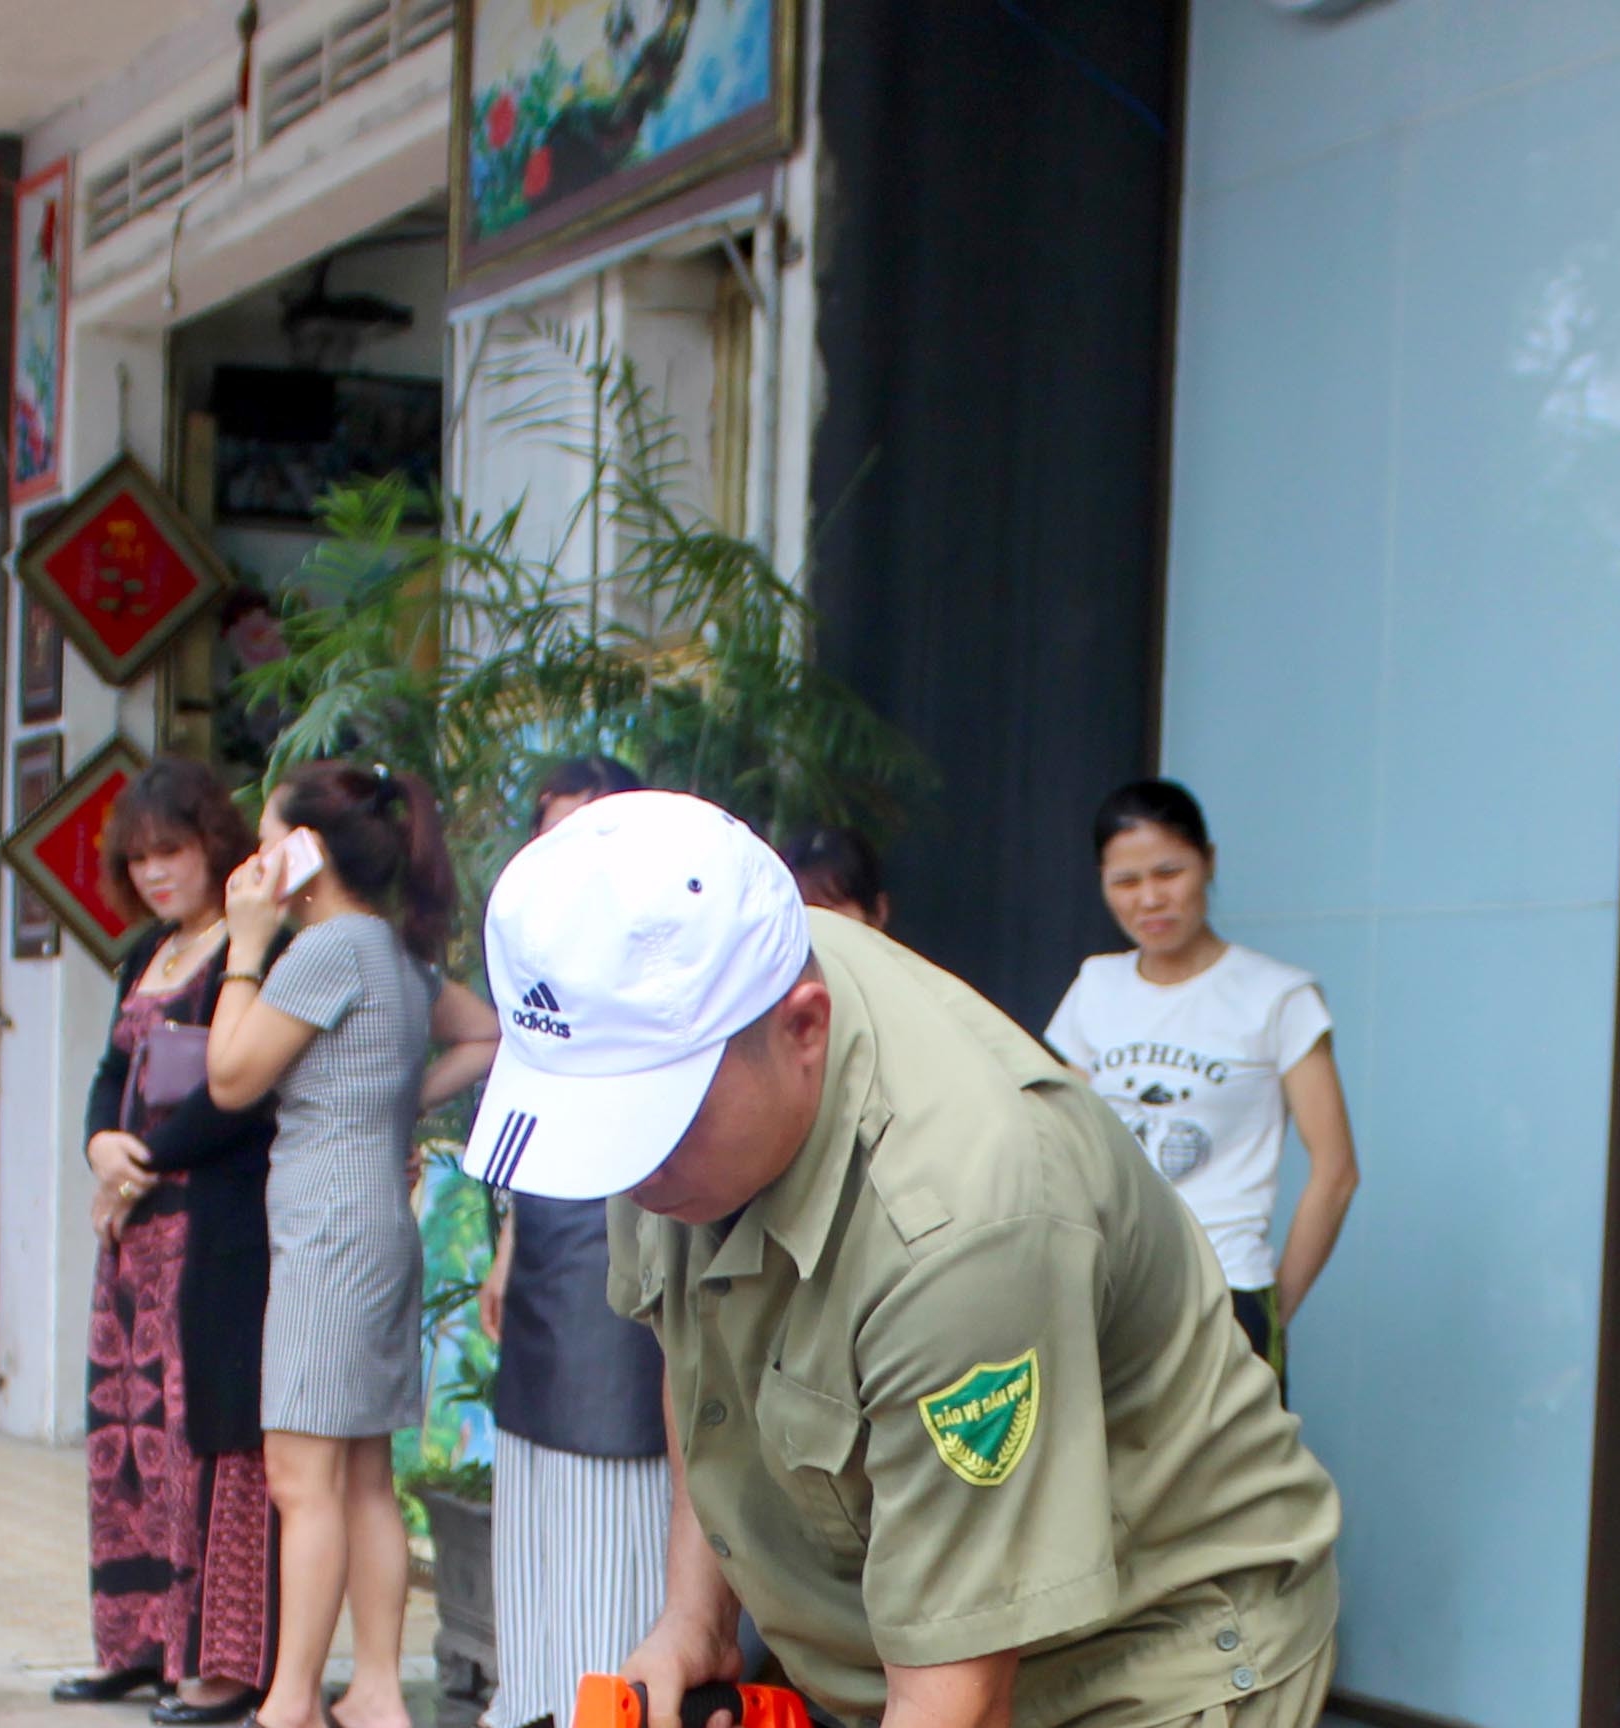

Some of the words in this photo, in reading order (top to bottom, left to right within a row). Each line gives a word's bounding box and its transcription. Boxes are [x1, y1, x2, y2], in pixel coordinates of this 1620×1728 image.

[512, 1009, 571, 1039] adidas
[934, 1405, 963, 1428] BẢO
[962, 1400, 982, 1422] VỆ
